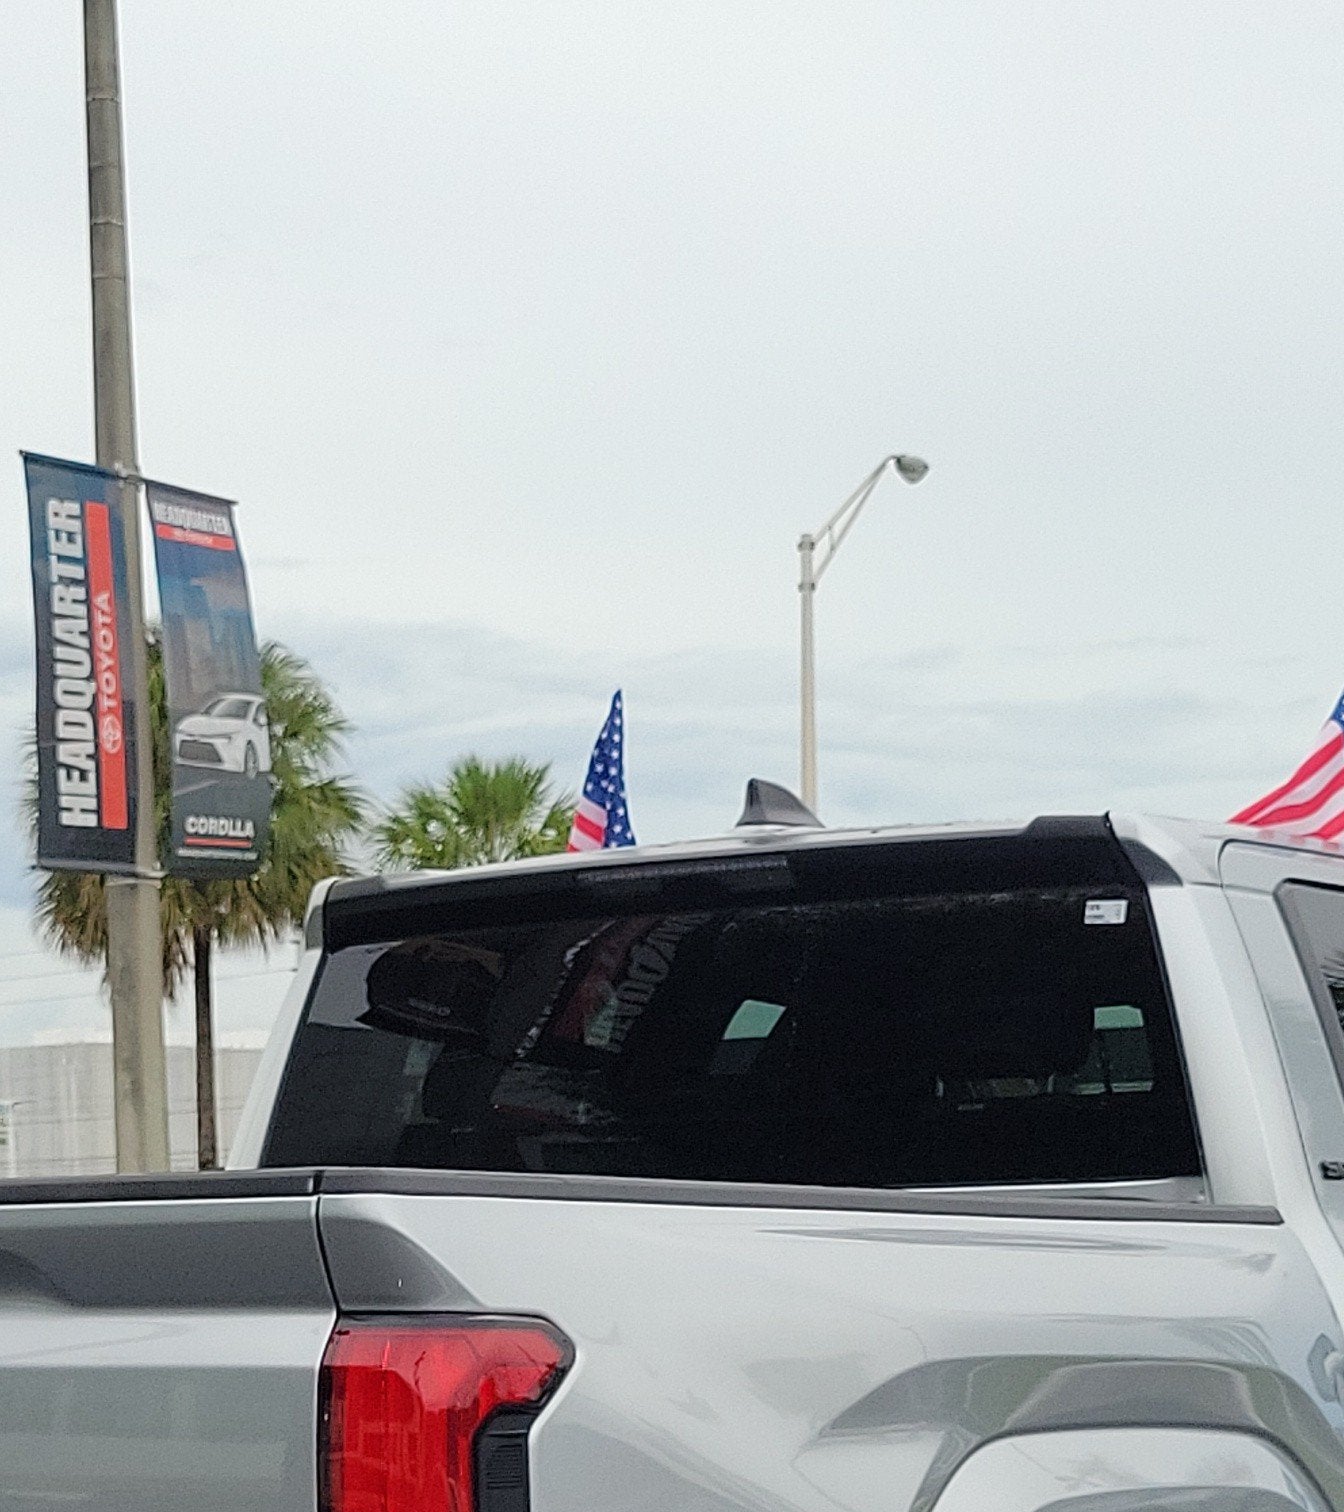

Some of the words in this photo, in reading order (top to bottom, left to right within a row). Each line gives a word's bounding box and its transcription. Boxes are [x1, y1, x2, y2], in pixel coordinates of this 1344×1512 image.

[47, 500, 98, 827] HEADQUARTER
[94, 592, 116, 708] TOYOTA
[185, 815, 255, 838] COROLLA
